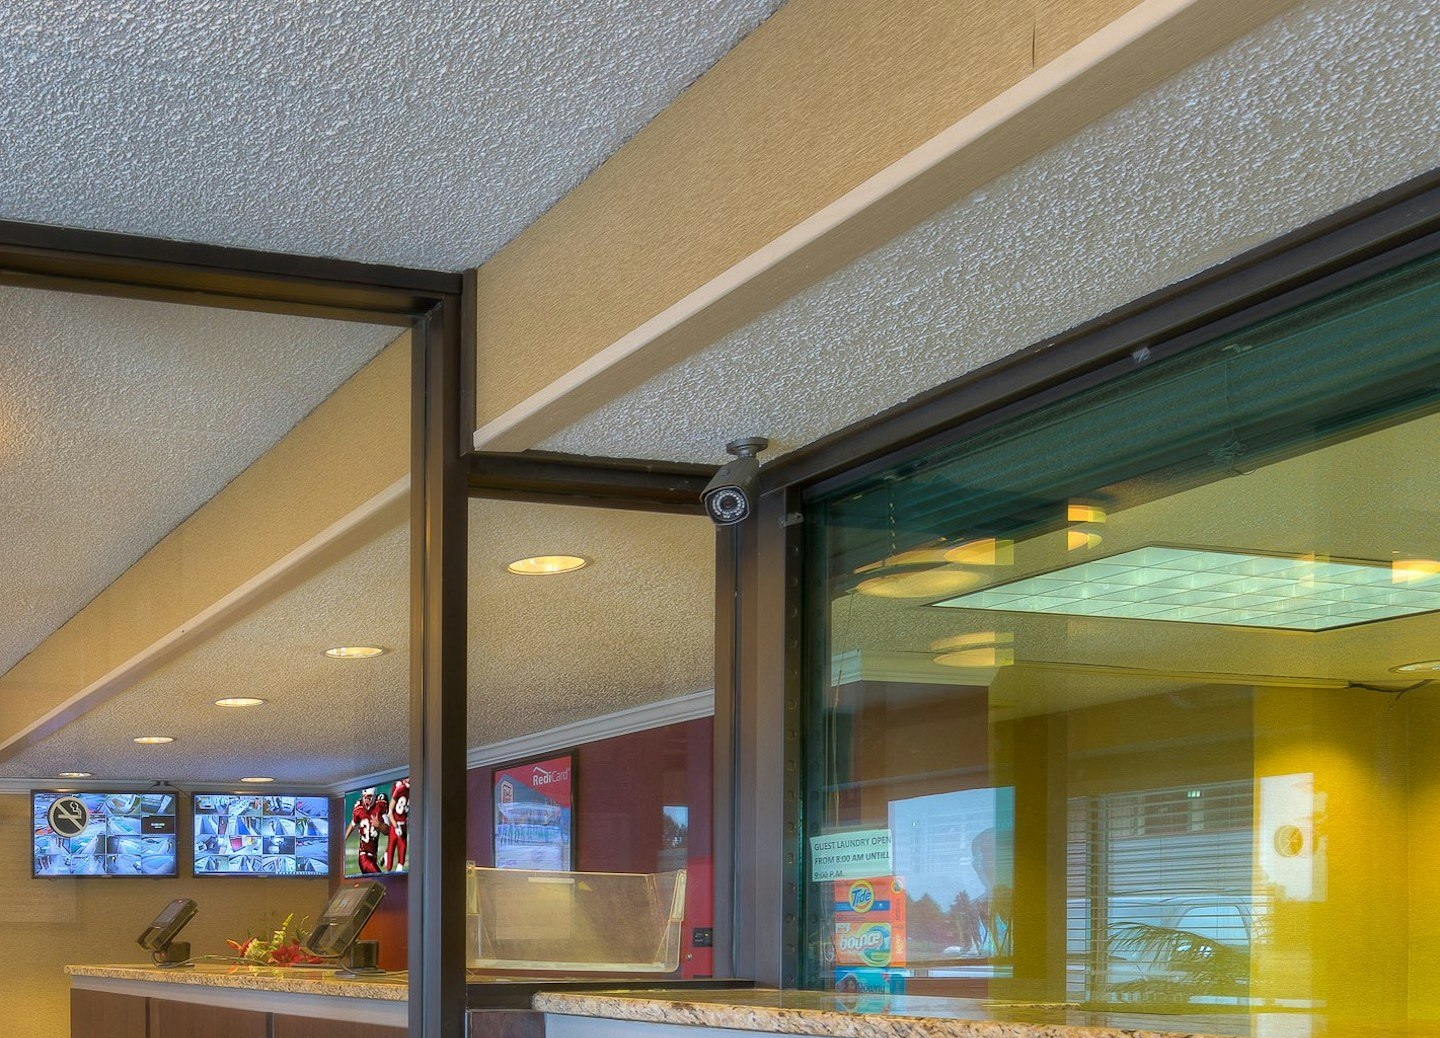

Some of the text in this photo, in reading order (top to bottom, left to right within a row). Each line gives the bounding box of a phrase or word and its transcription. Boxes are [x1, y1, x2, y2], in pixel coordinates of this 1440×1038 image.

[532, 768, 568, 786] RediCard
[814, 836, 891, 851] GUEST LAUNDRY OPEN
[814, 851, 890, 865] FROM 8:00 AM UNTILL
[852, 888, 871, 907] Tide
